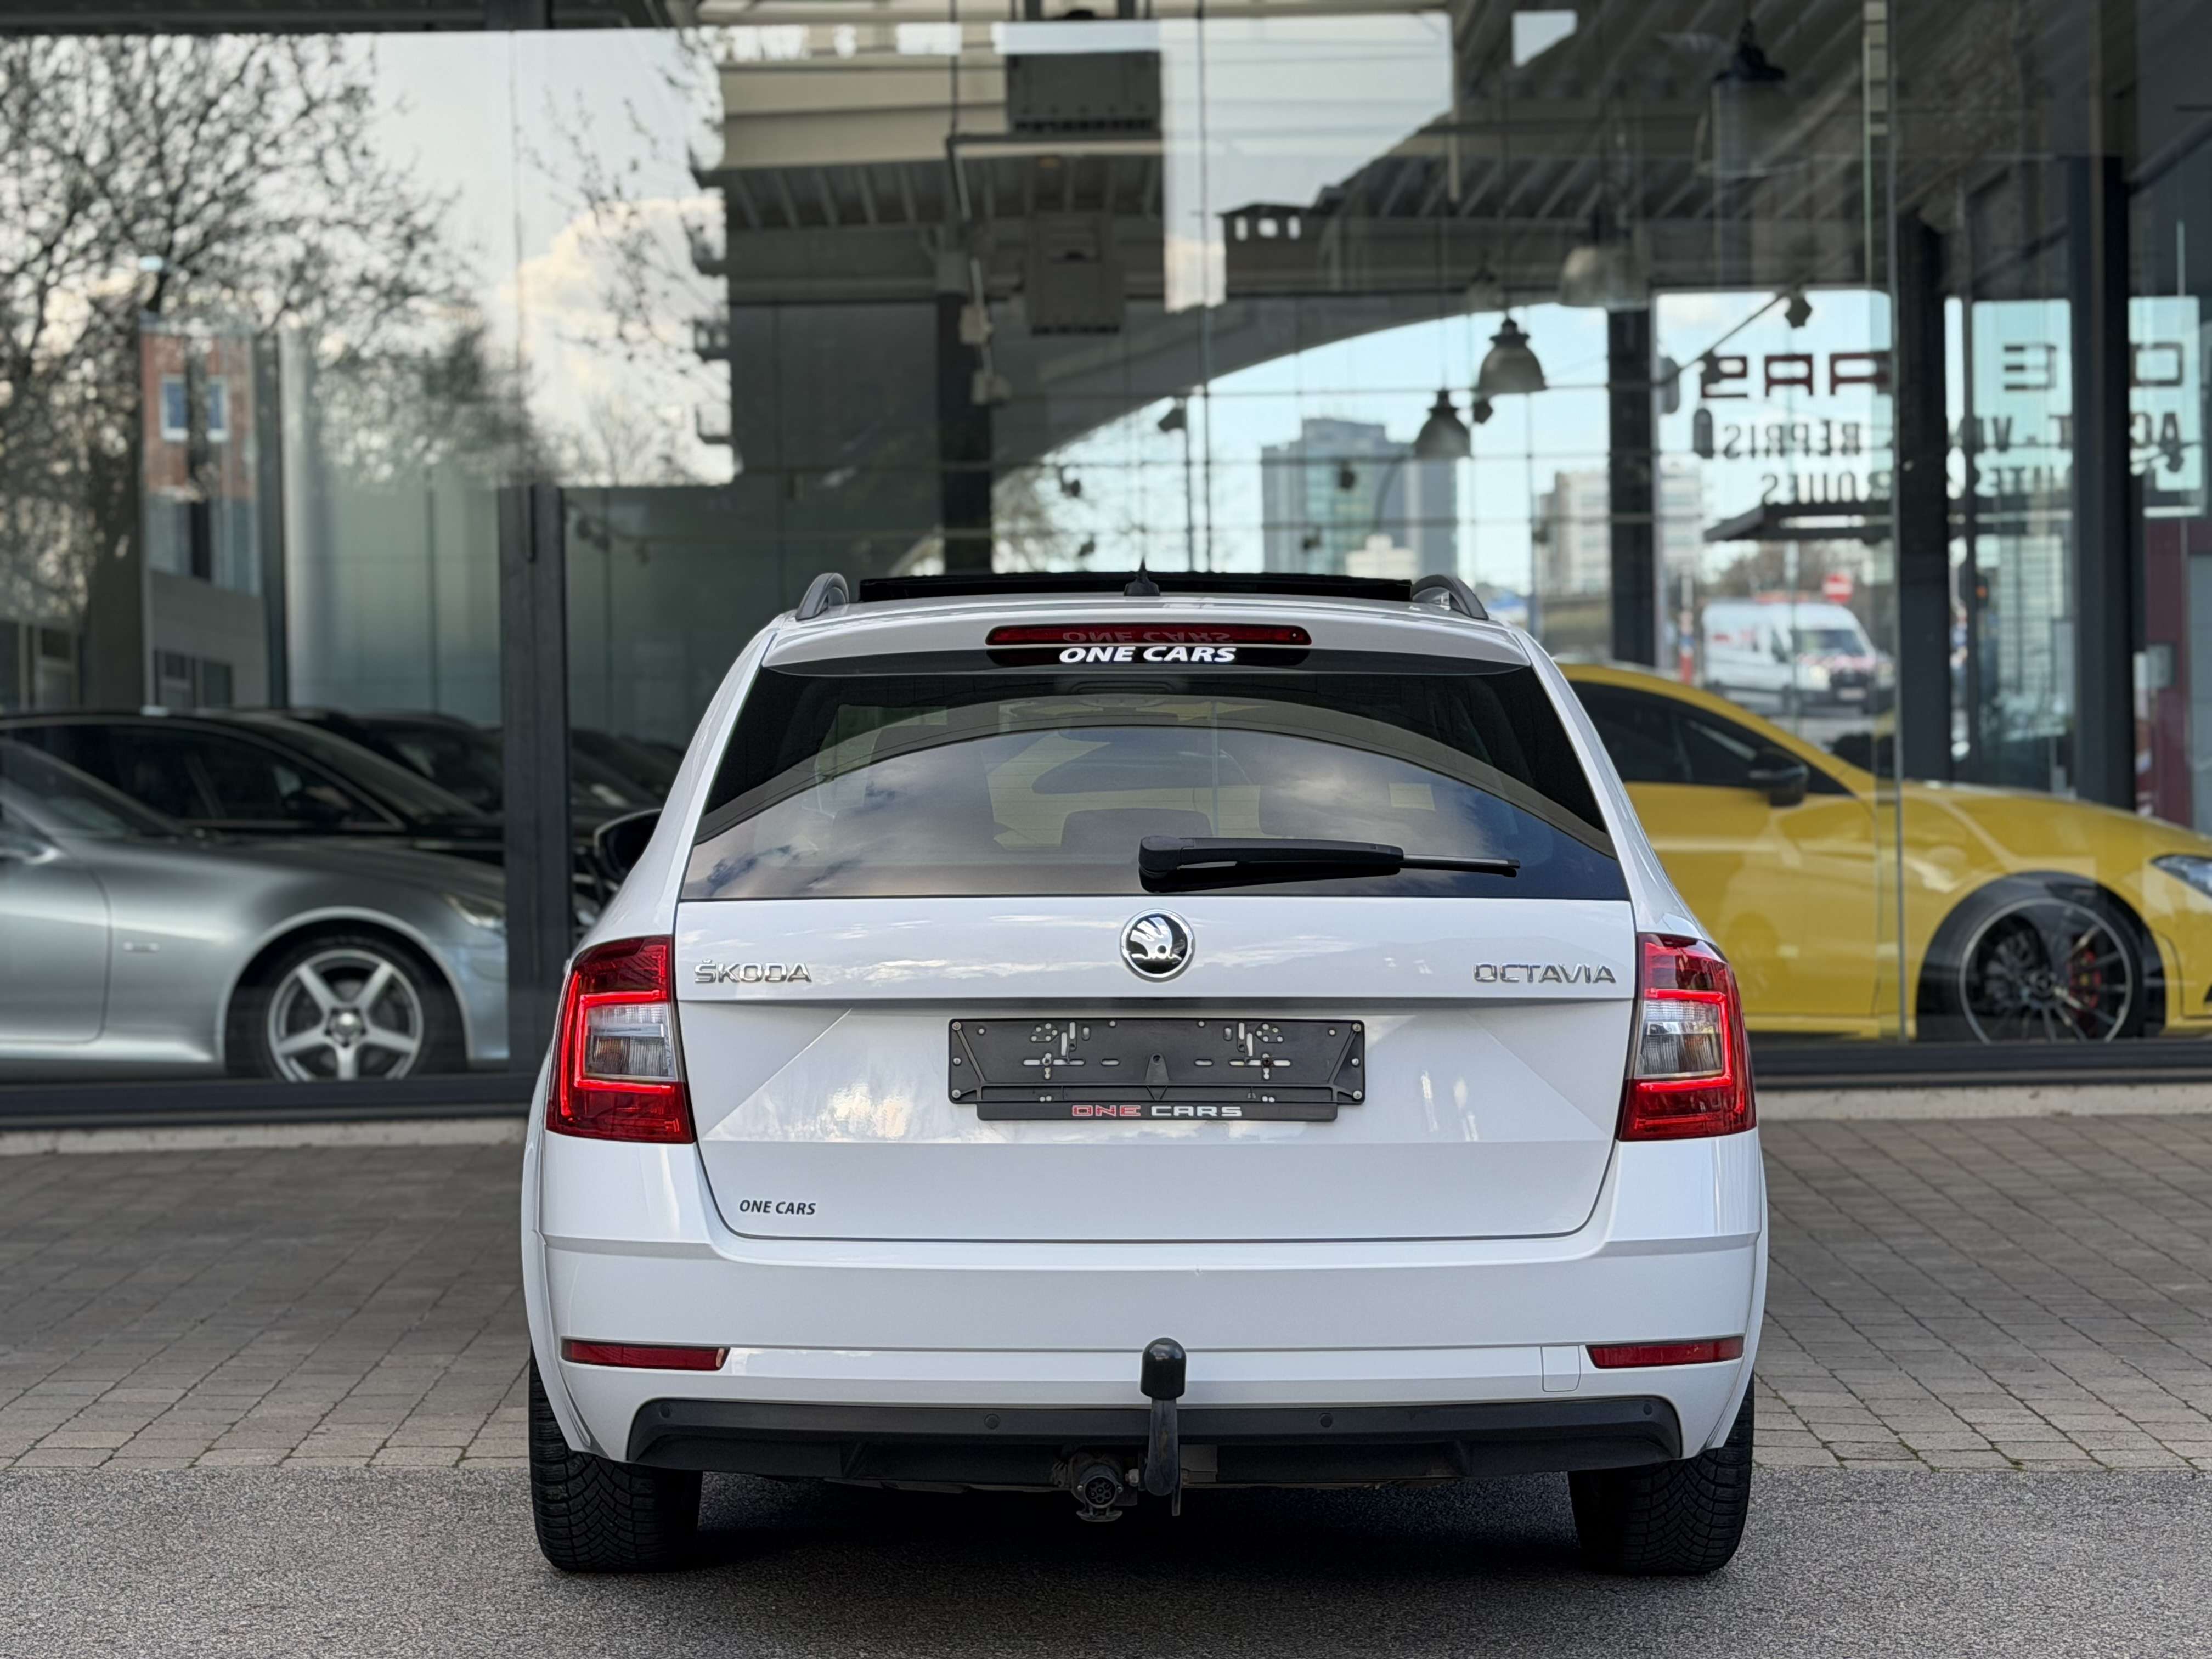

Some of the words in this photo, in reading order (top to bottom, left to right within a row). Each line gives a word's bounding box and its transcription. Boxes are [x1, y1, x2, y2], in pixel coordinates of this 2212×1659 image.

[1059, 646, 1136, 663] ONE
[1143, 646, 1237, 662] CARS
[695, 959, 812, 983] ŠKODA
[1474, 963, 1616, 983] OCTAVIA
[1071, 1105, 1141, 1117] ONE
[1151, 1105, 1243, 1117] CARS
[739, 1200, 772, 1213] ONE
[775, 1201, 816, 1215] CARS
